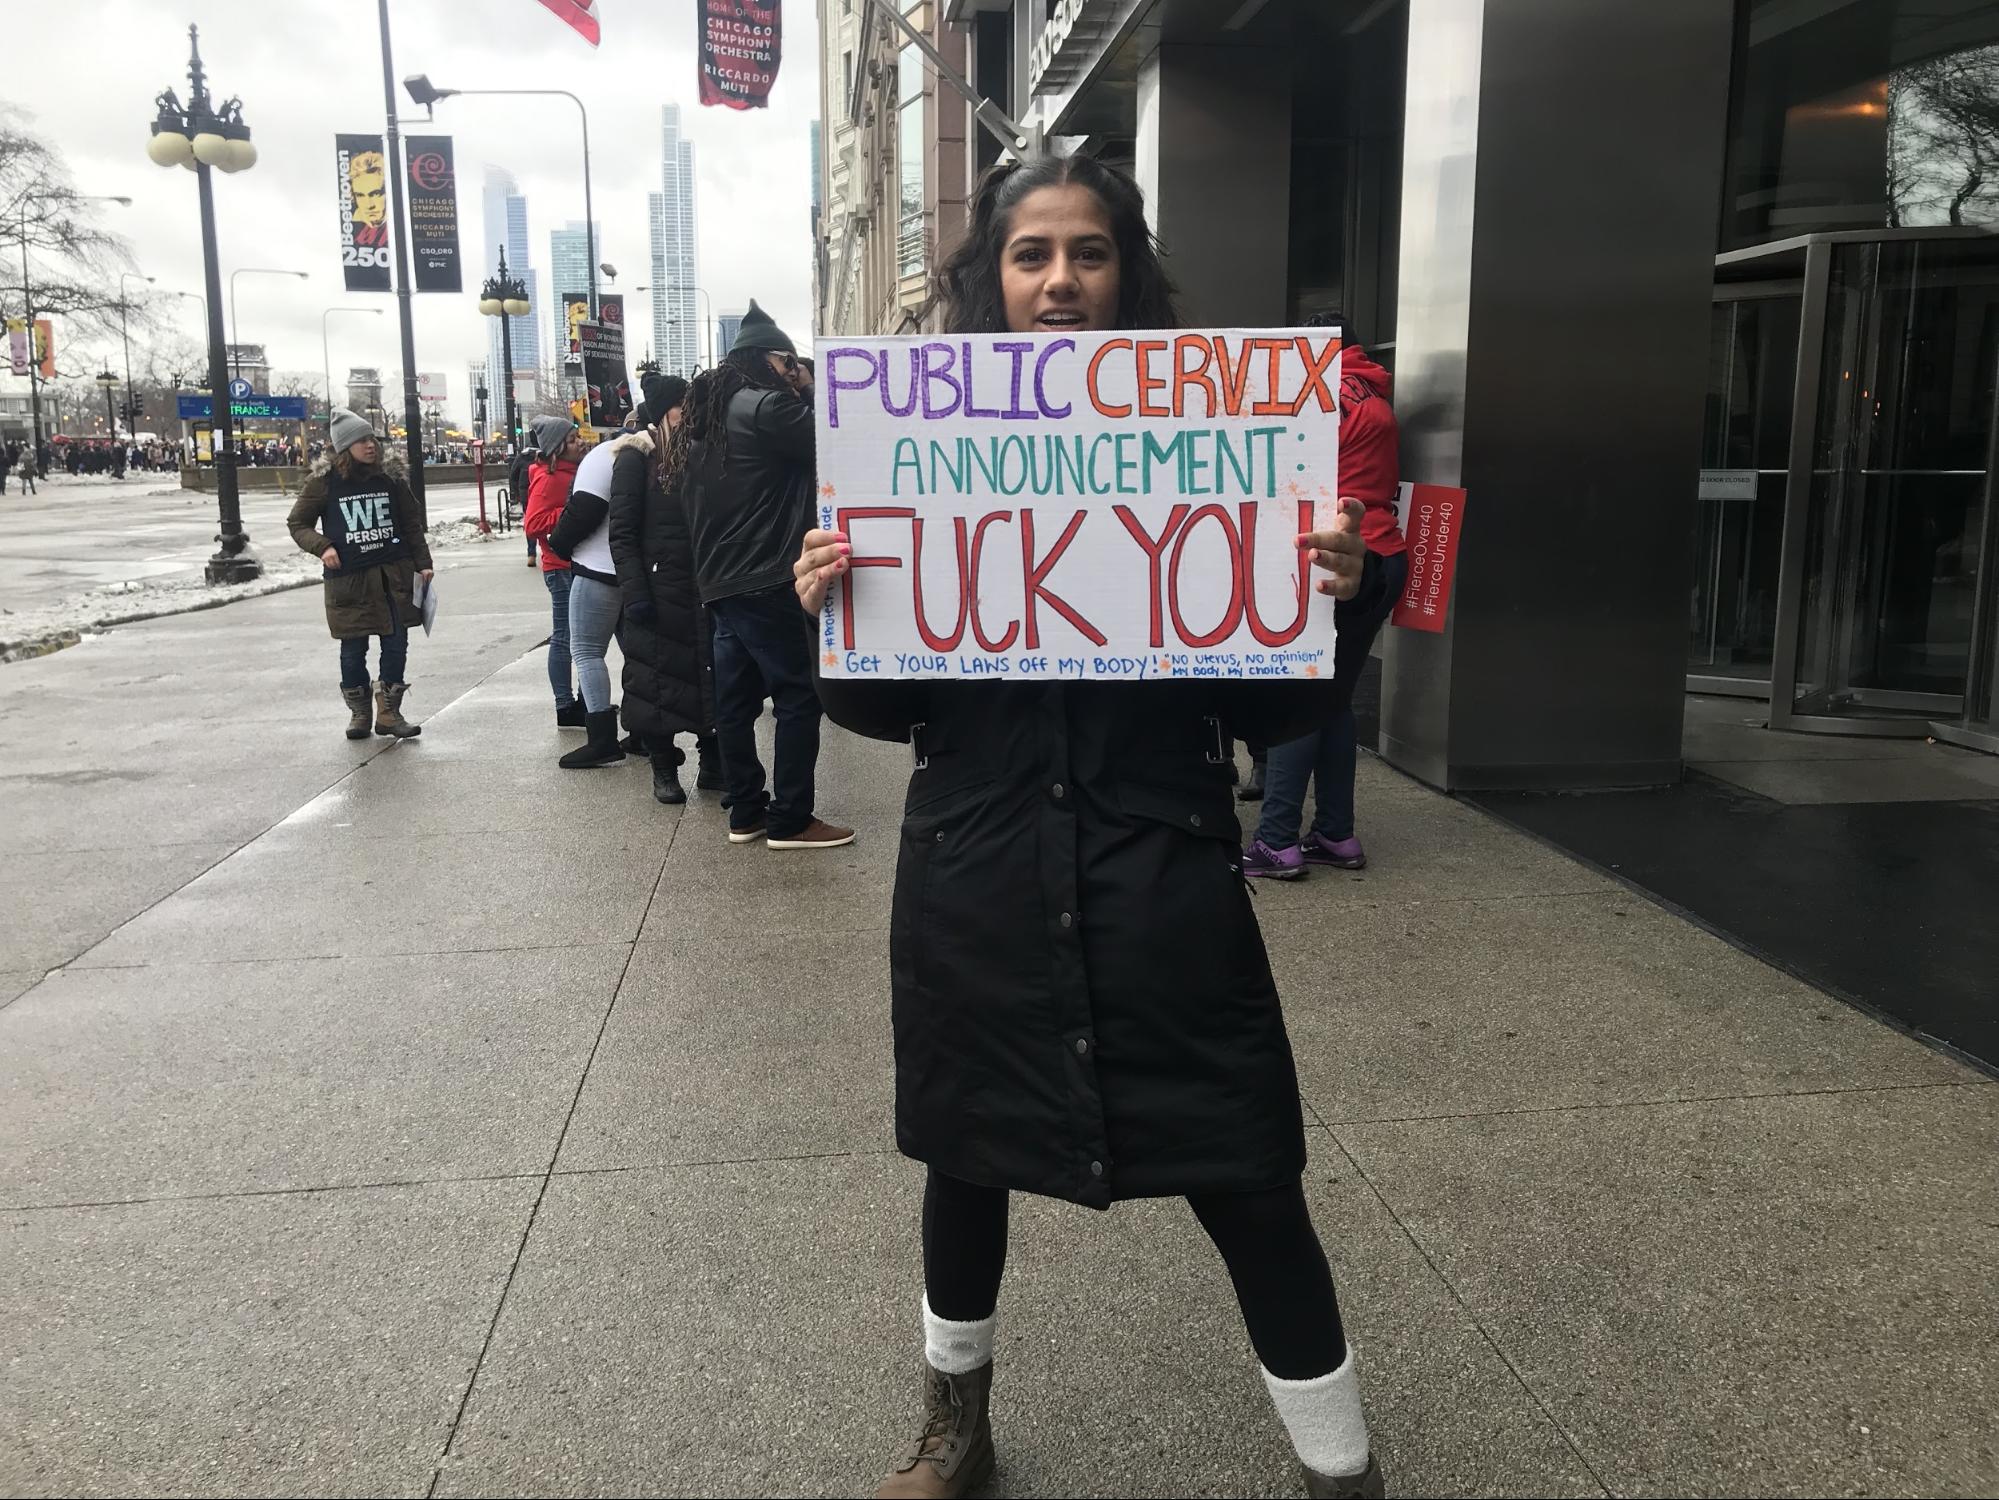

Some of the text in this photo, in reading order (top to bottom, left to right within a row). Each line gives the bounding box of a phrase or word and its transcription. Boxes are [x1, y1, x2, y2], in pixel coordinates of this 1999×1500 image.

[752, 10, 771, 20] THE
[706, 17, 773, 37] CHICAGO
[706, 30, 772, 49] SYMPHONY
[705, 41, 772, 62] ORCHESTRA
[704, 63, 770, 84] RICCARDO
[720, 80, 749, 94] MUTI
[338, 150, 354, 246] Beethoven
[412, 198, 455, 206] CHICAGO
[412, 204, 456, 212] SYMPHONY
[412, 211, 456, 219] ORCHESTRA
[343, 246, 391, 268] 250
[564, 352, 581, 364] 25
[826, 338, 1076, 428] PUBLIC
[1086, 334, 1342, 418] CERVIX
[230, 406, 270, 415] TRANCE
[338, 492, 389, 502] NEVERTHELESS
[339, 497, 393, 532] WE
[345, 526, 394, 545] PERSIST
[1405, 504, 1434, 609] #FierceOver40
[1423, 502, 1454, 616] #FierceUnder40
[836, 500, 1315, 652] FUCK YOU
[845, 652, 882, 673] Get
[894, 653, 948, 674] YOUR
[960, 655, 1010, 674] LAWS
[1058, 658, 1085, 679] MY
[1245, 653, 1265, 665] NO
